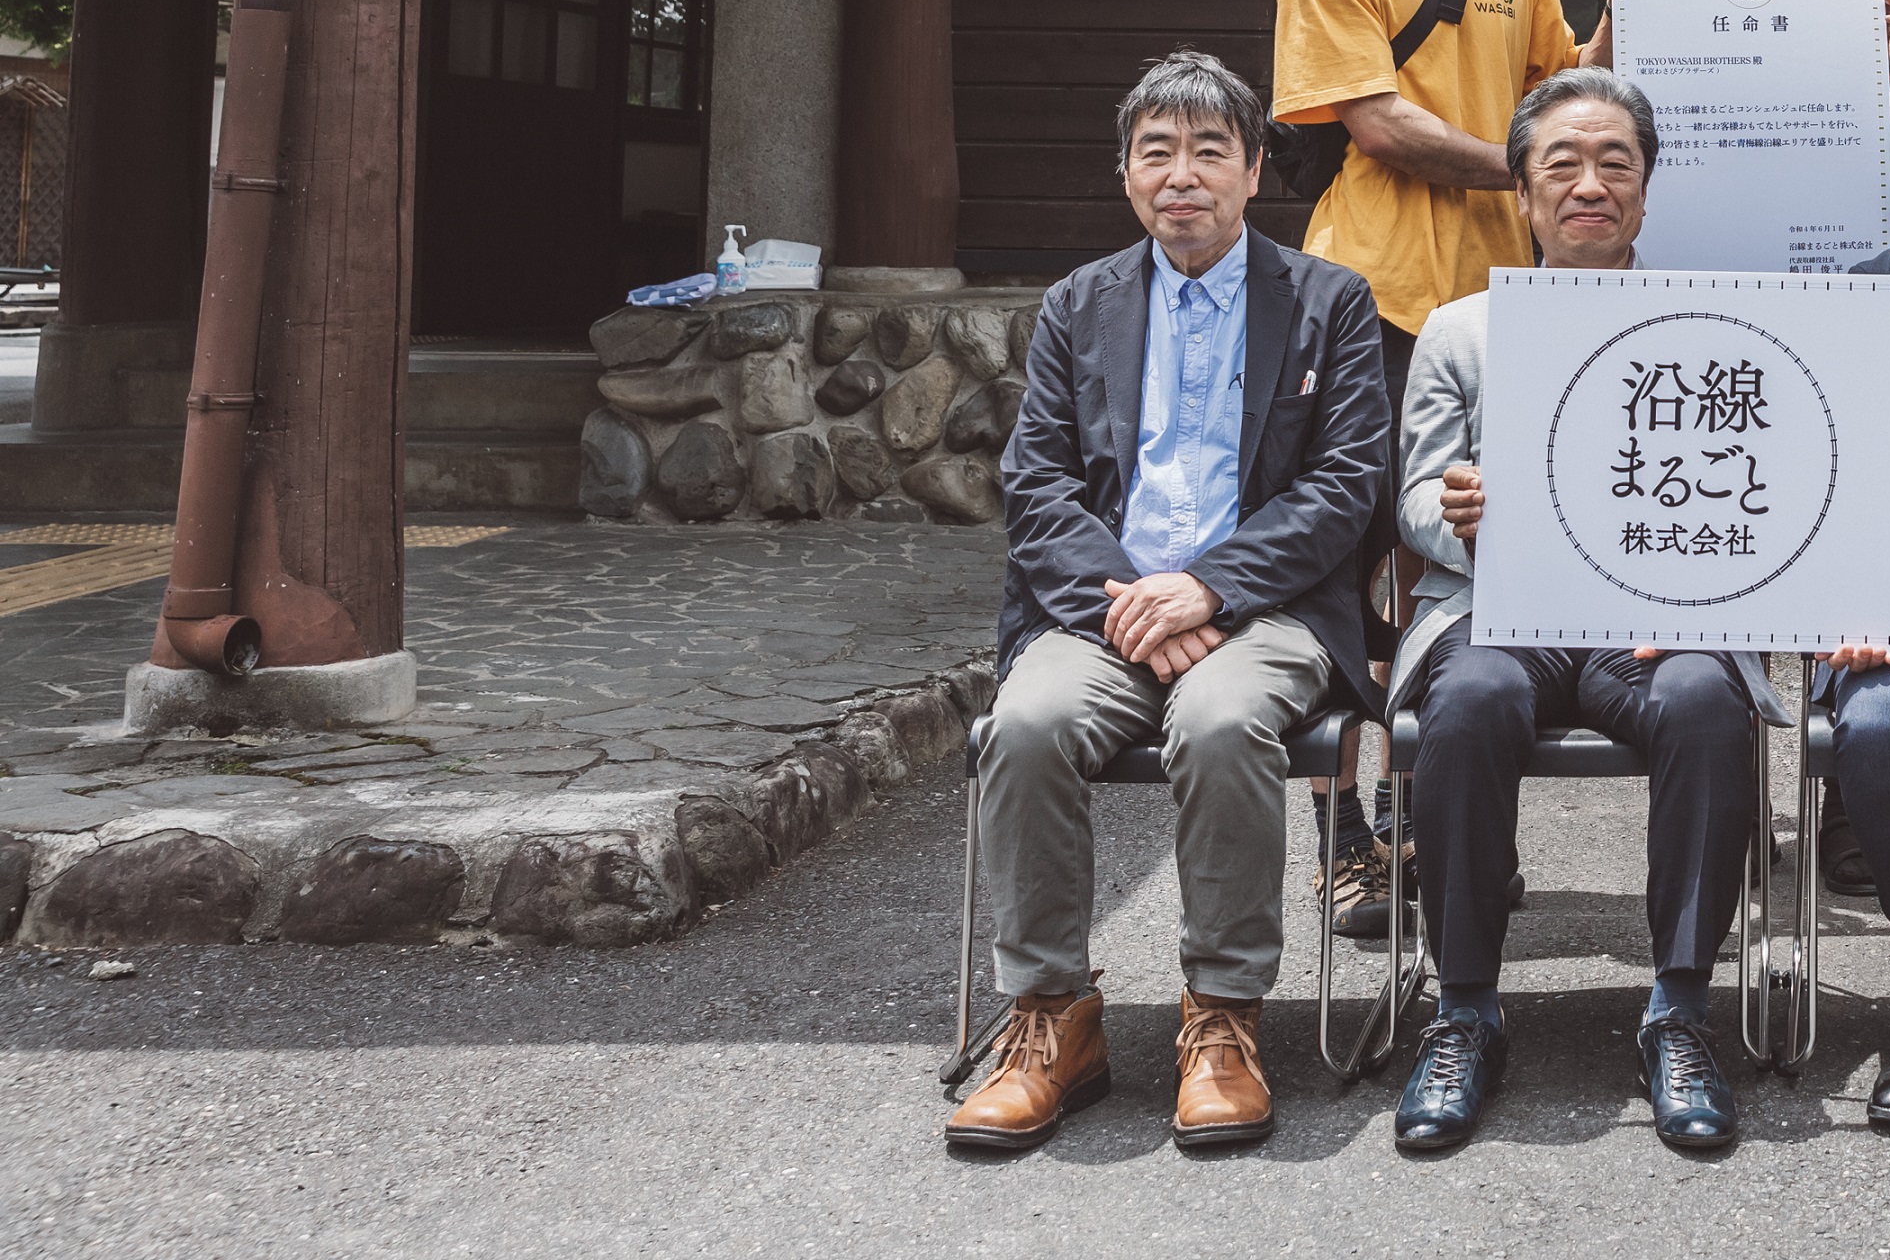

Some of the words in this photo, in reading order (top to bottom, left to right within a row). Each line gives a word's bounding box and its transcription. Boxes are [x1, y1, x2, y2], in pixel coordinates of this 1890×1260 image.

[1474, 2, 1515, 19] WASABI
[1712, 15, 1789, 32] 任命書
[1636, 57, 1667, 65] TOKYO
[1668, 57, 1702, 65] WASABI
[1703, 56, 1752, 65] BROTHERS
[1653, 103, 1856, 115] なたを沿線まるごとコンシェルジュに任命します。
[1789, 241, 1873, 251] 沿線まるごと株式会社
[1621, 359, 1771, 433] 沿線
[1610, 436, 1769, 515] まるごと
[1619, 521, 1756, 556] 株式会社
